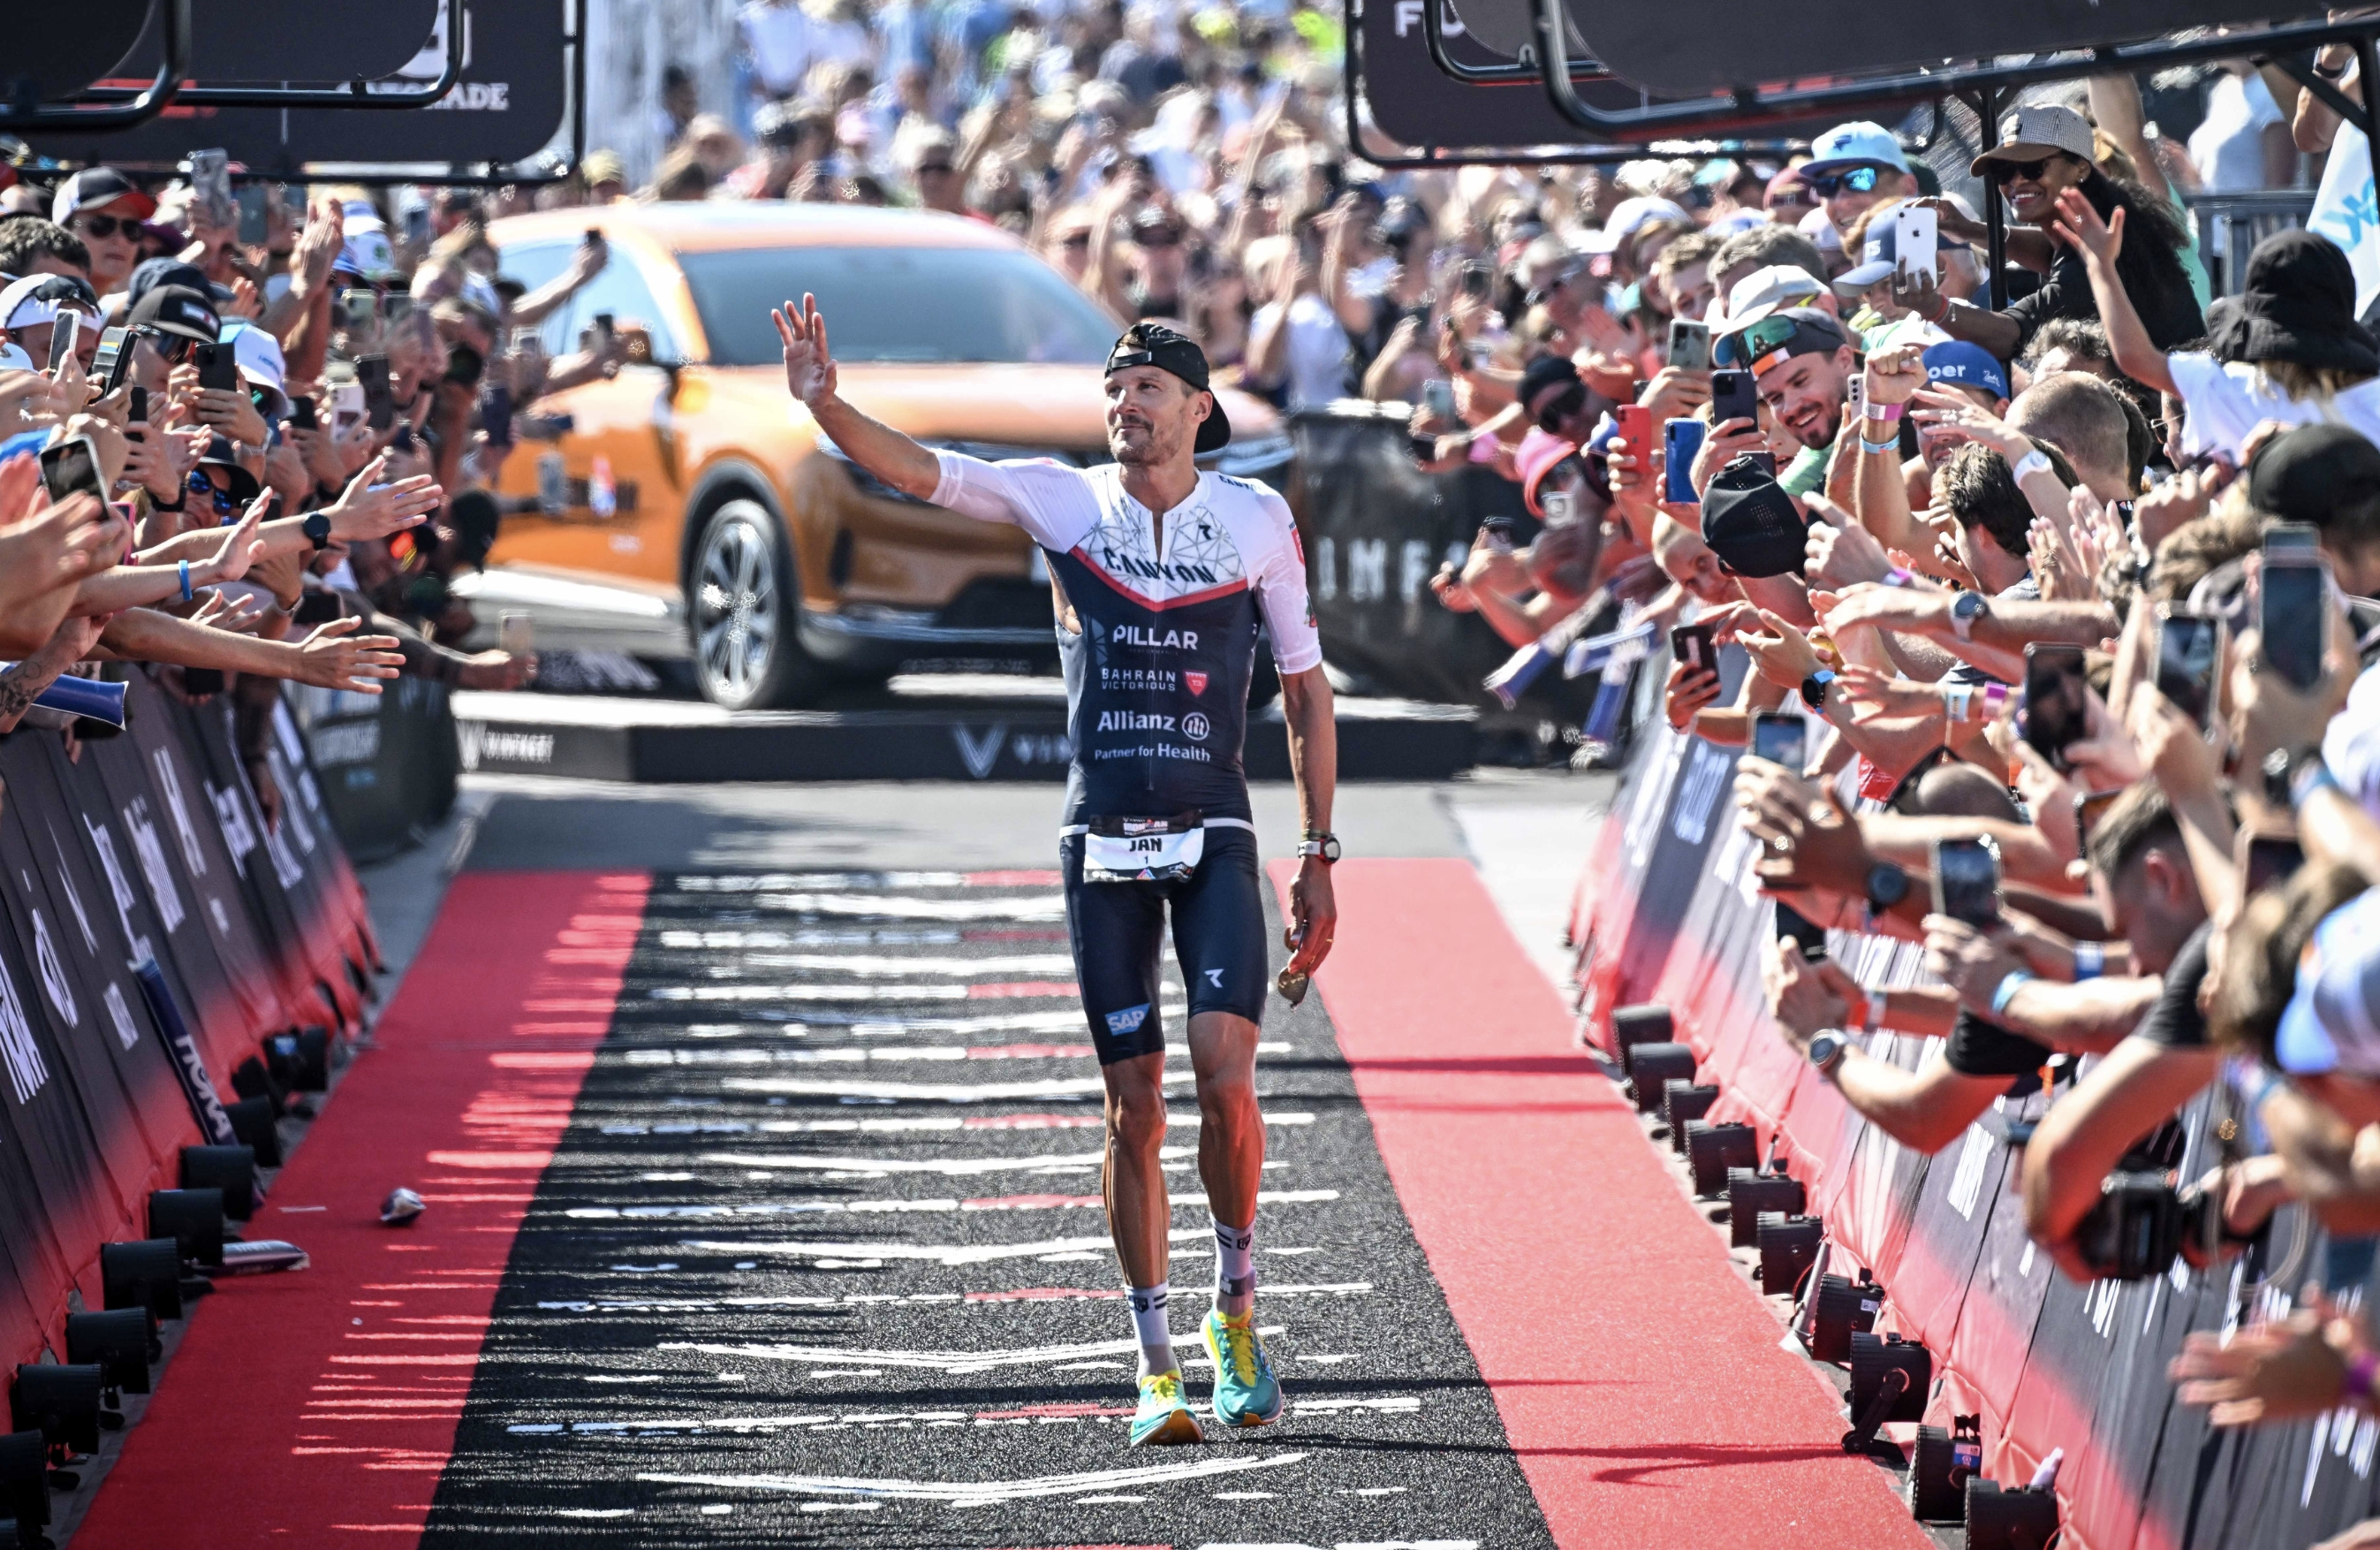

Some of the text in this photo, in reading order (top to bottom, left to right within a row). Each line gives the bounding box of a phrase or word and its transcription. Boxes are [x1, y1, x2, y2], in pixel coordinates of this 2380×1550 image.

[1103, 546, 1217, 583] CANYON
[1113, 624, 1198, 650] PILLAR
[1102, 668, 1176, 683] BAHRAIN
[1102, 681, 1176, 691] VICTORIOUS
[1096, 710, 1176, 732] Allianz
[1095, 742, 1211, 762] Partner for Health
[1129, 838, 1163, 853] JAN
[1143, 855, 1148, 865] 1
[1107, 1010, 1146, 1032] SAP
